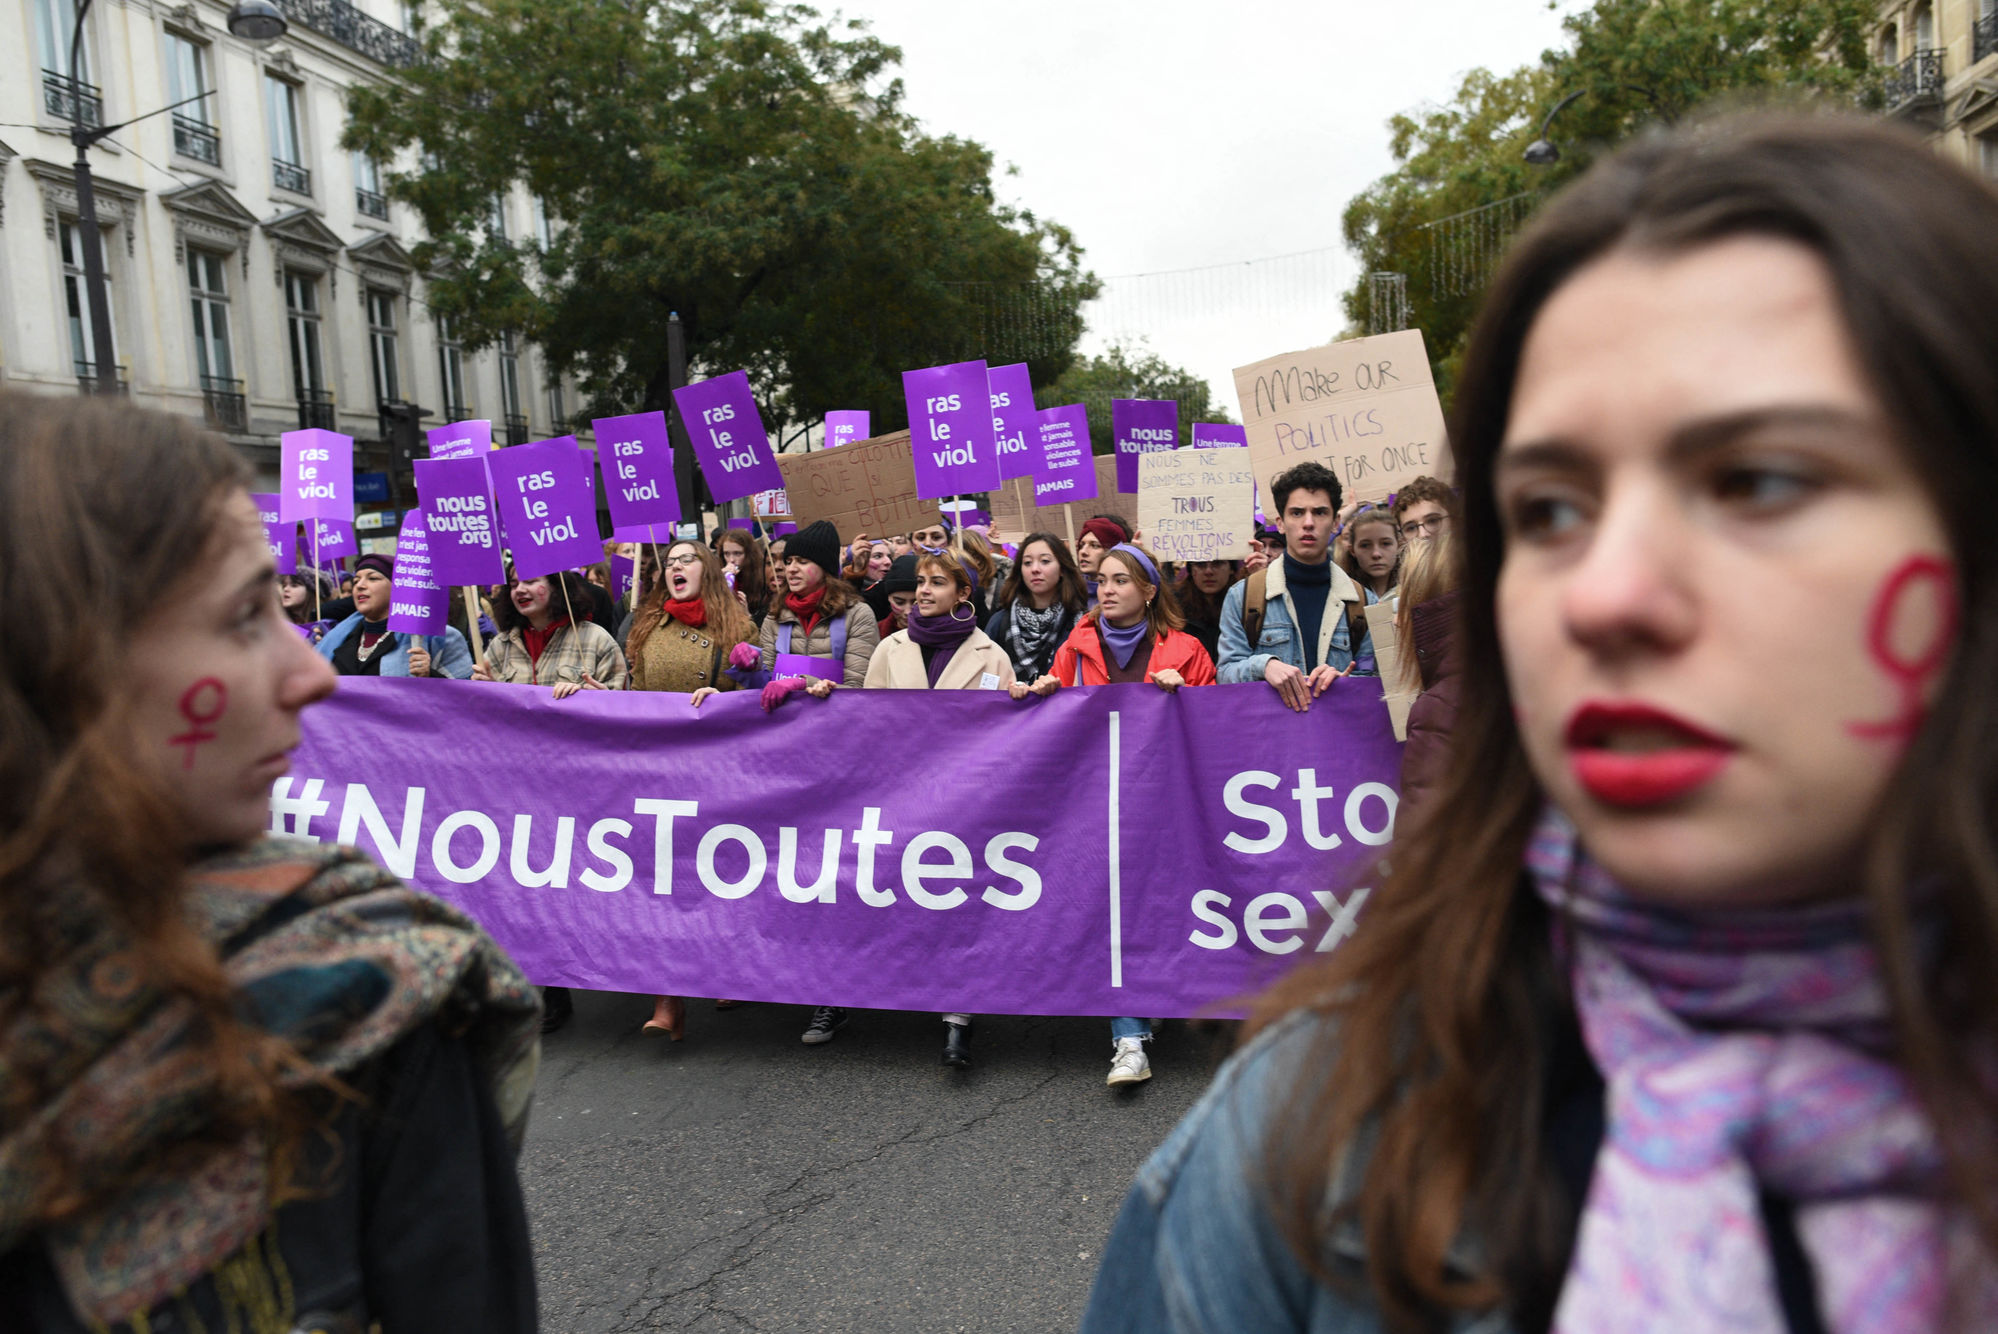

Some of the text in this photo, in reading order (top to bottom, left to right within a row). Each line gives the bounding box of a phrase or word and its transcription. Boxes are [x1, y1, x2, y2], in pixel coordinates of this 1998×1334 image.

[926, 394, 962, 415] ras
[990, 392, 1011, 409] as
[702, 403, 736, 426] ras
[834, 424, 855, 434] ras
[929, 418, 952, 442] le
[993, 416, 1005, 432] e
[1274, 408, 1384, 456] POLITICS
[709, 428, 734, 450] le
[834, 435, 847, 447] le
[1047, 430, 1074, 442] jamais
[1131, 427, 1174, 441] nous
[1197, 438, 1241, 448] Une femme
[299, 448, 329, 462] ras
[613, 440, 644, 457] ras
[933, 440, 977, 468] viol
[1119, 439, 1174, 454] toutes
[719, 444, 761, 473] viol
[1146, 453, 1218, 469] NOUS NE
[1344, 454, 1376, 487] FOR
[1381, 442, 1430, 473] ONCE
[299, 463, 318, 481] le
[617, 460, 637, 480] le
[516, 470, 556, 494] ras
[811, 469, 855, 497] QUE
[1036, 478, 1074, 496] JAMAIS
[1142, 471, 1252, 489] SOMMES PAS DES
[298, 481, 336, 499] viol
[622, 479, 660, 502] viol
[436, 495, 487, 513] nous
[522, 496, 549, 520] le
[855, 491, 937, 528] BOTTE
[427, 512, 490, 532] toutes
[529, 515, 579, 547] viol
[1158, 518, 1214, 532] FEMMES
[458, 530, 493, 549] .org
[1152, 533, 1234, 551] RÉVOLTONS
[396, 553, 432, 565] responsa
[407, 564, 434, 577] violen
[391, 602, 431, 618] JAMAIS
[268, 775, 1043, 911] #NousToutes
